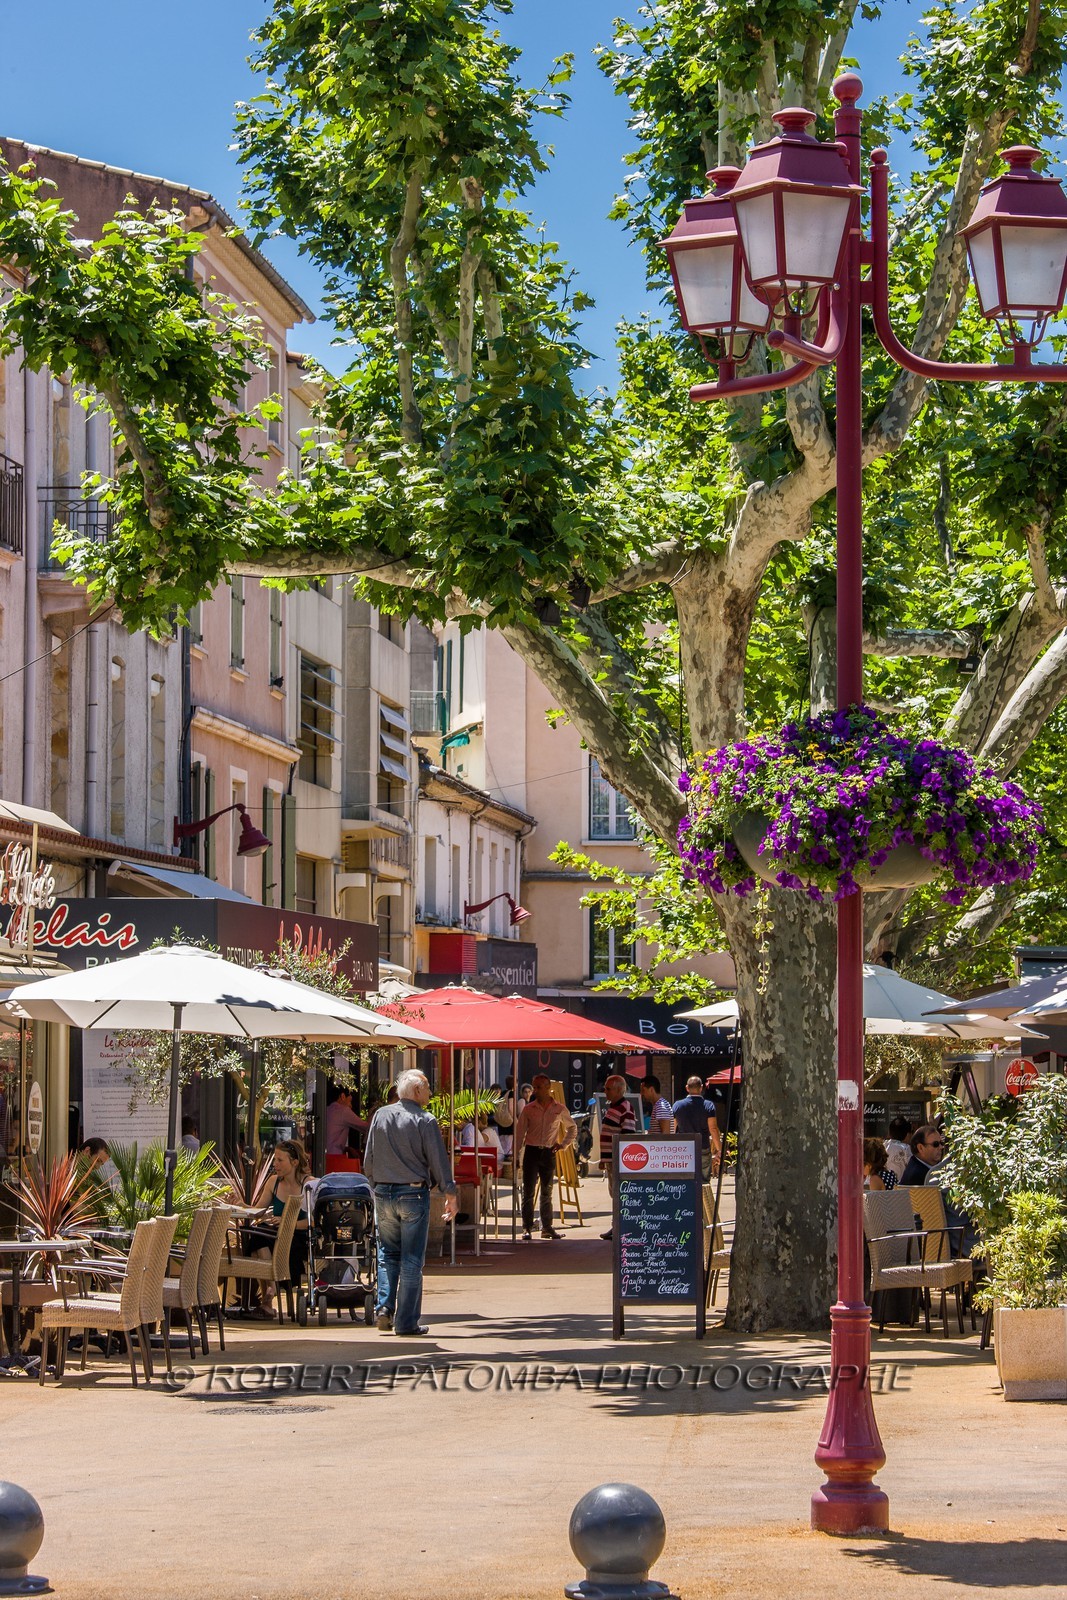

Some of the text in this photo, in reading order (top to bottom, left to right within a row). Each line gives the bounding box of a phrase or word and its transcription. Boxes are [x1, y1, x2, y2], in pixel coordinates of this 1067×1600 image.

[104, 1035, 113, 1048] Le
[1006, 1072, 1038, 1086] Coca-Col
[650, 1145, 687, 1153] Partagez
